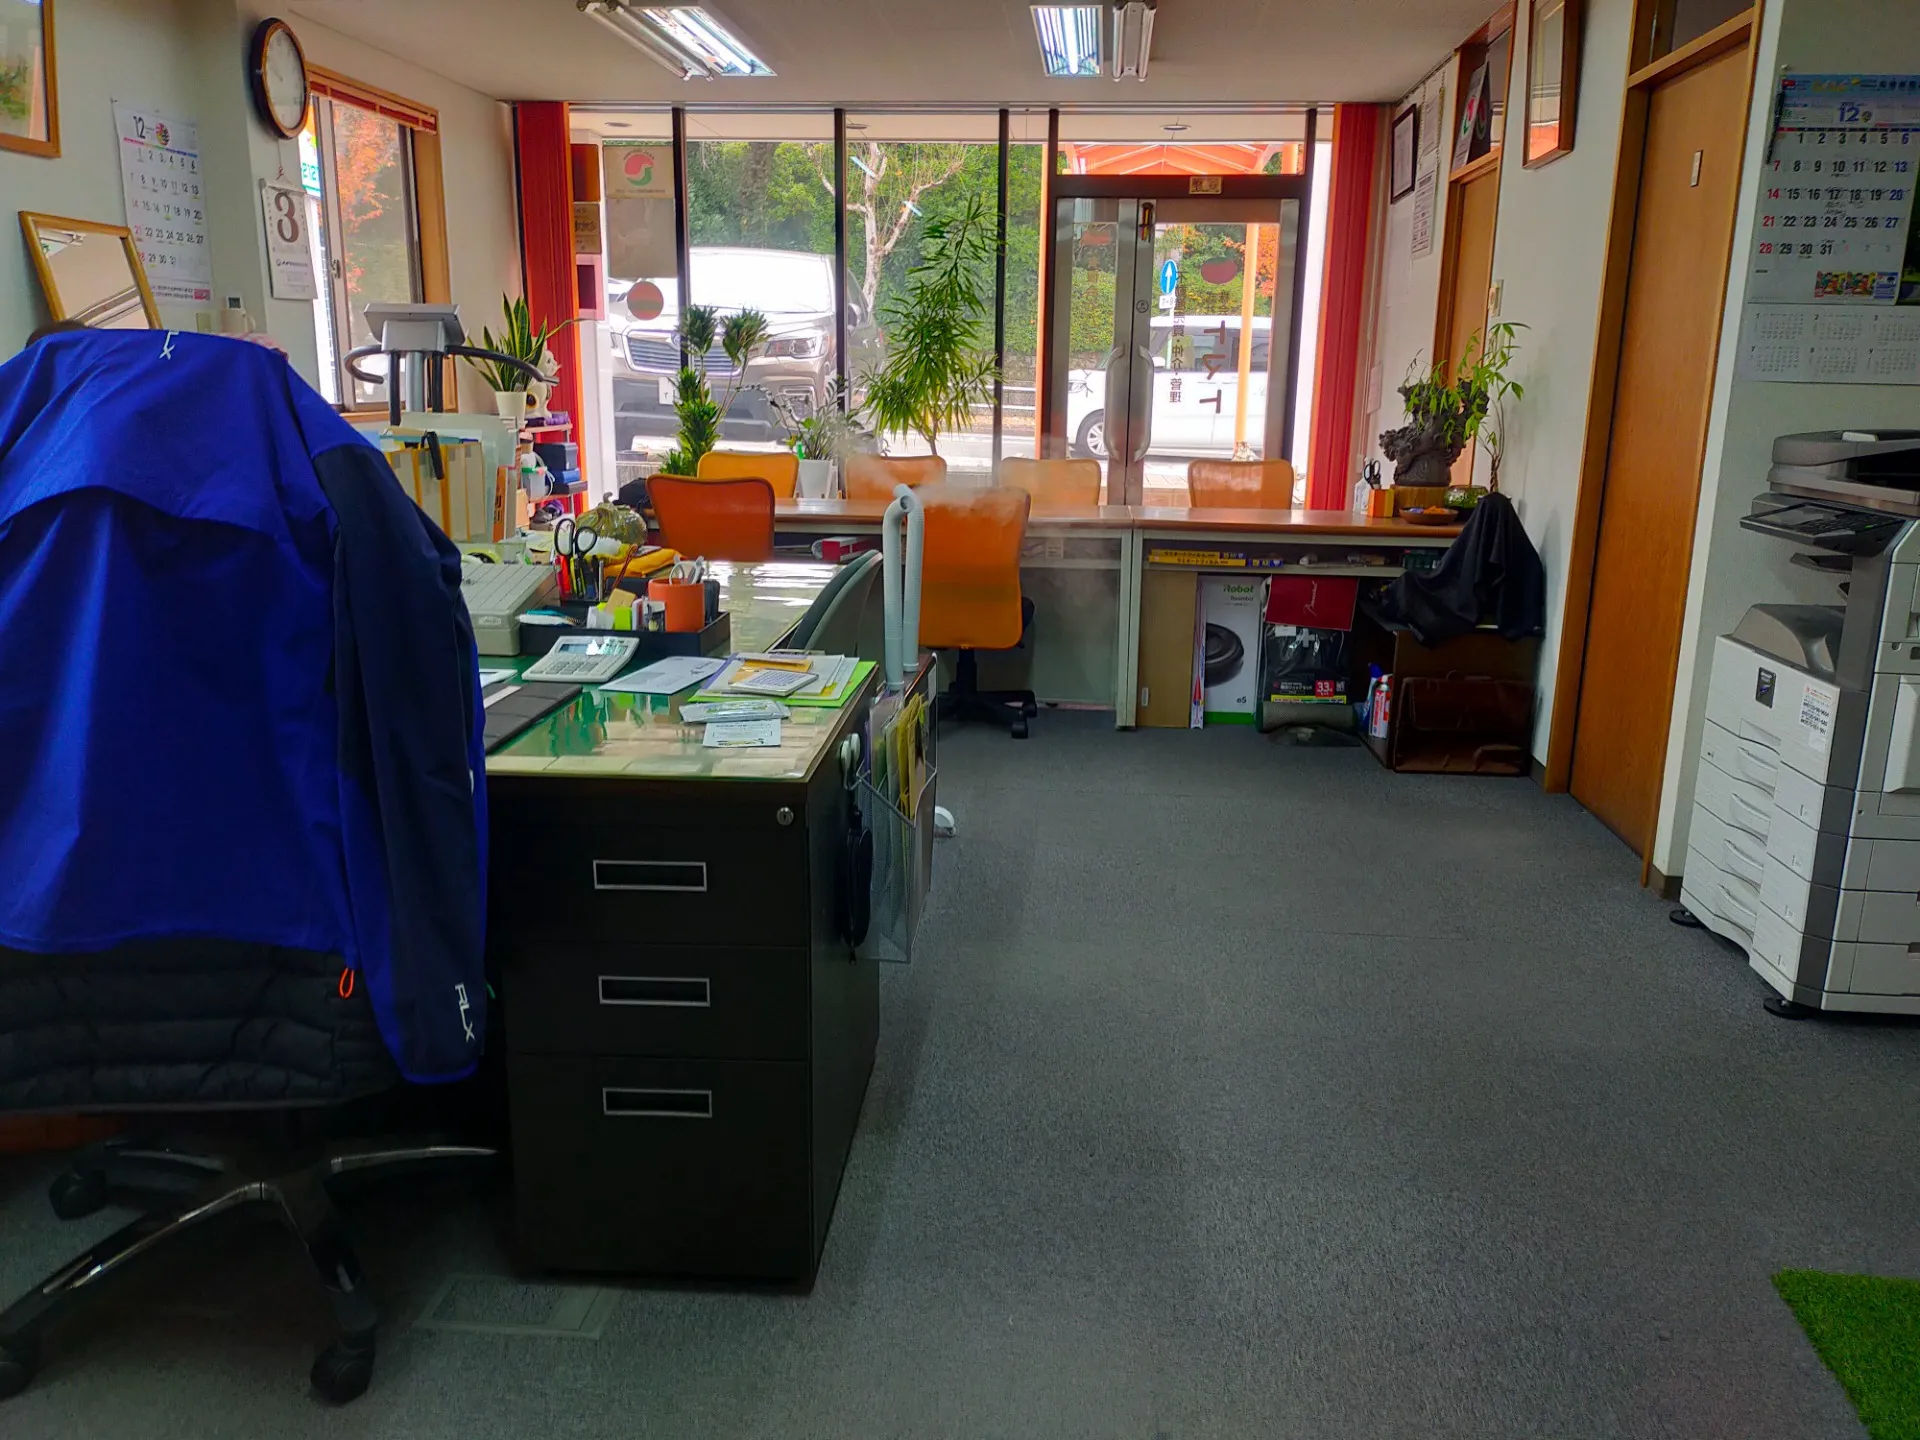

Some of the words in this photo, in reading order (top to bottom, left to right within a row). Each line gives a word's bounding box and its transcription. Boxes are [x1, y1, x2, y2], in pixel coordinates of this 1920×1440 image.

[1838, 106, 1860, 122] 12
[133, 116, 146, 139] 12
[1798, 133, 1804, 144] 1
[1818, 133, 1826, 144] 2
[1838, 133, 1846, 144] 3
[1859, 133, 1868, 144] 4
[1880, 133, 1888, 144] 5
[1901, 133, 1910, 144] 6
[1773, 160, 1781, 172] 7
[1793, 160, 1801, 172] 8
[1814, 160, 1822, 172] 9
[1832, 160, 1846, 172] 10
[1853, 160, 1865, 172] 11
[1874, 160, 1886, 172] 12
[1894, 161, 1908, 173] 13
[1767, 188, 1780, 200] 14
[1787, 188, 1800, 200] 15
[1808, 188, 1821, 200] 16
[1828, 188, 1842, 200] 17
[1850, 189, 1862, 200] 18
[1869, 189, 1882, 200] 19
[1889, 189, 1904, 200] 20
[163, 204, 170, 214] 17
[275, 192, 299, 243] 3
[1763, 216, 1775, 227] 21
[1782, 216, 1796, 228] 22
[1803, 216, 1816, 228] 23
[1824, 217, 1838, 228] 24
[1844, 217, 1858, 228] 25
[1864, 217, 1878, 228] 26
[1884, 217, 1899, 228] 27
[145, 227, 153, 238] 22
[156, 229, 164, 238] 23
[166, 230, 174, 240] 24
[1759, 243, 1772, 254] 28
[1779, 243, 1792, 254] 29
[1800, 244, 1813, 255] 30
[1820, 244, 1833, 255] 31
[1223, 584, 1255, 593] iRobot
